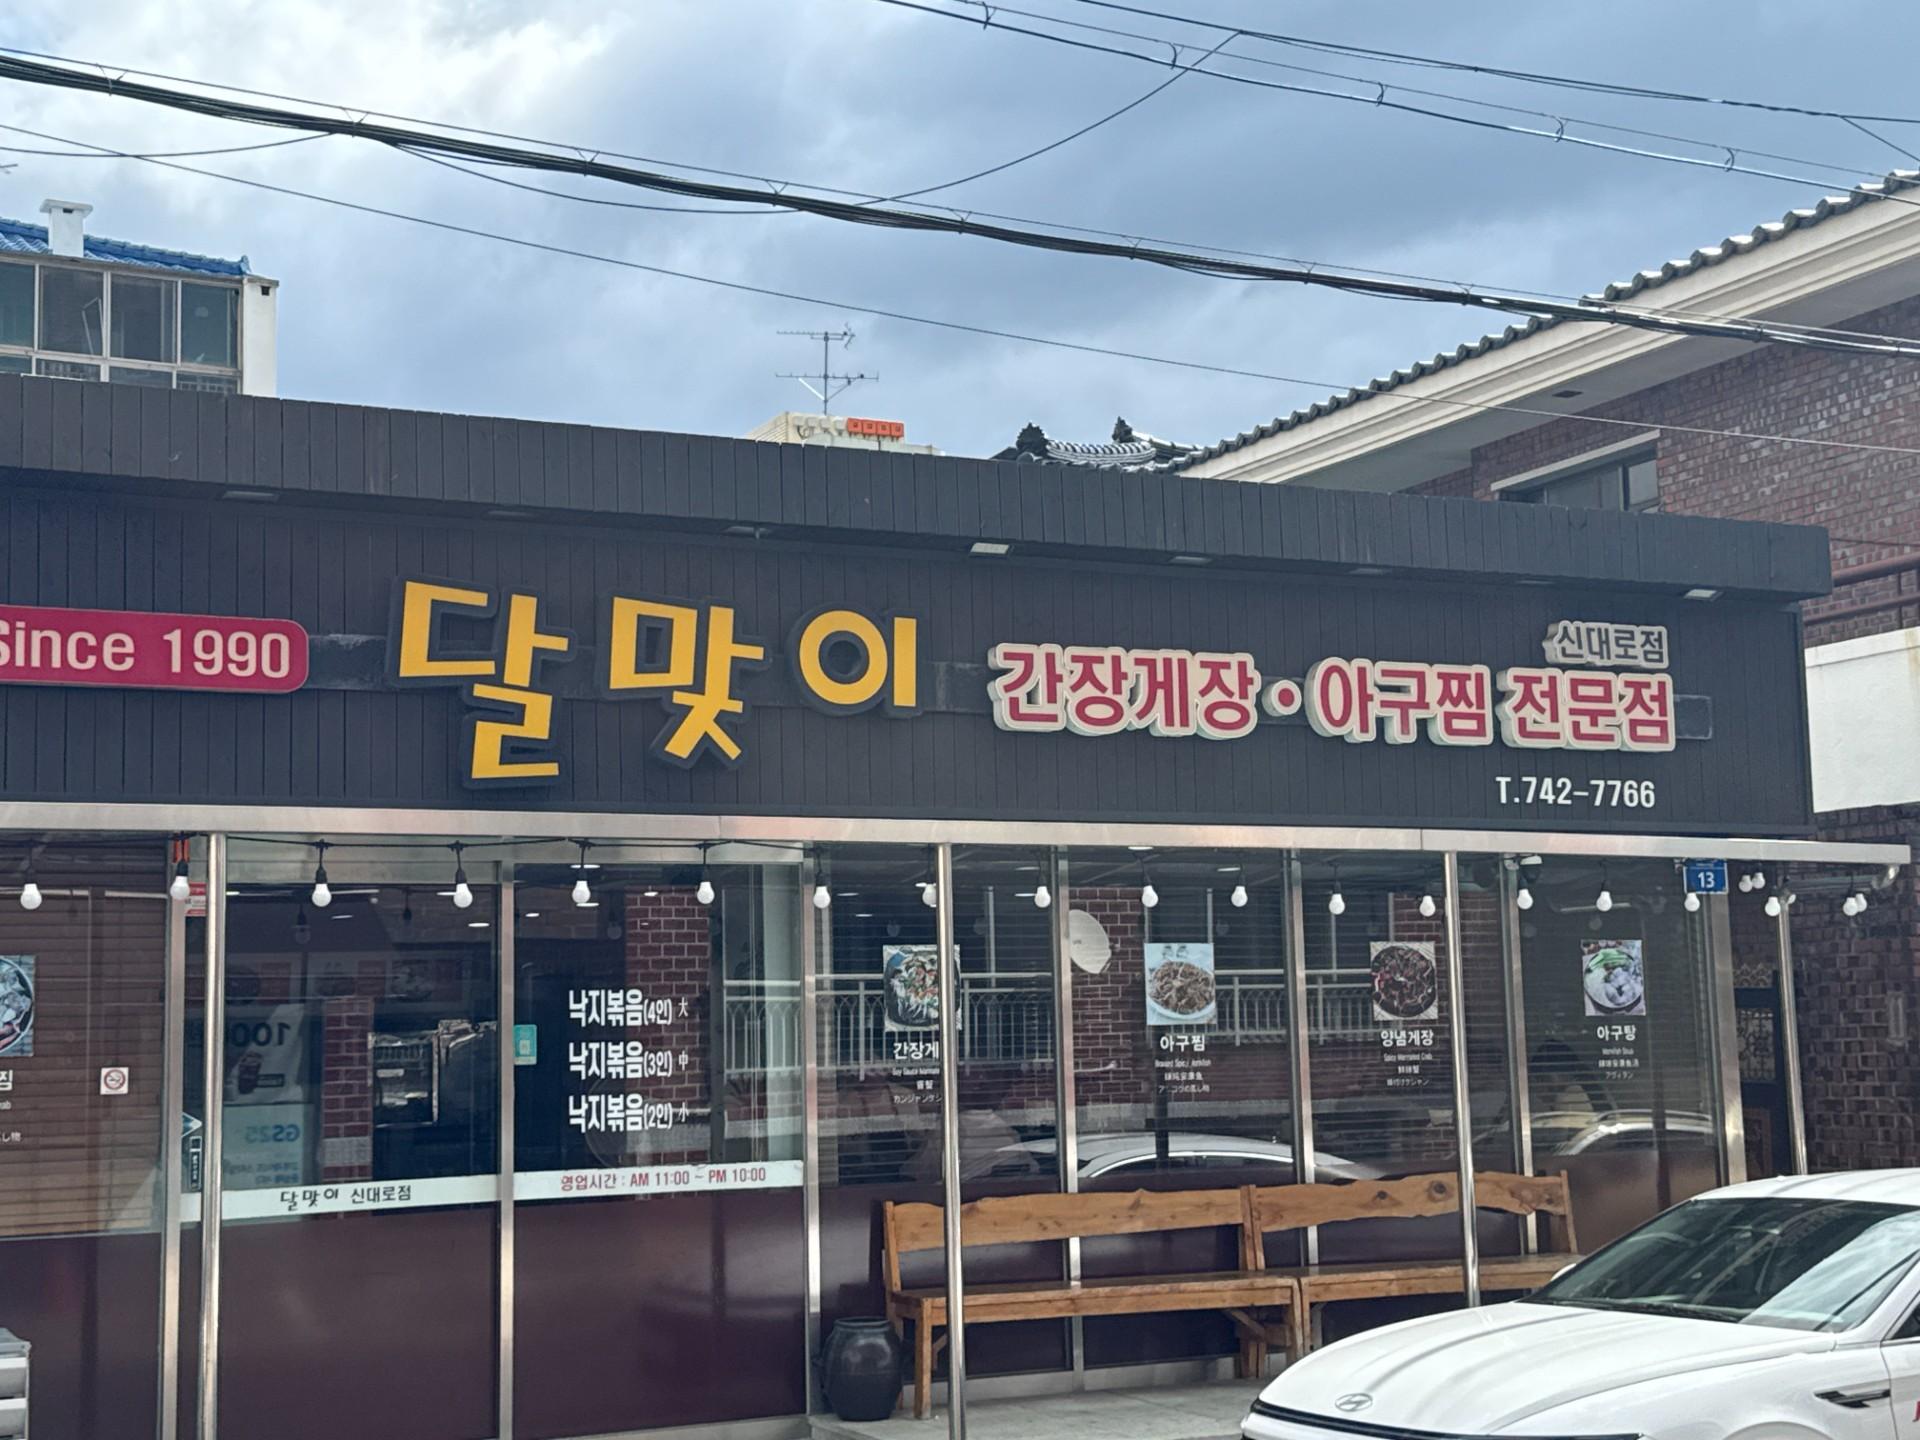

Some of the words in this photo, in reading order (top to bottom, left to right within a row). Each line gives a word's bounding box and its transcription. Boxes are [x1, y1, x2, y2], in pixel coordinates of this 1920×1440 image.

[163, 628, 290, 679] 1990
[1557, 625, 1664, 663] 신대로점
[1511, 674, 1670, 745] 전문점
[1495, 776, 1656, 808] T.742-7766
[1697, 871, 1715, 888] 13
[568, 989, 673, 1027] 낙지볶음(4인)
[678, 996, 689, 1018] 大
[1160, 1033, 1206, 1052] 아구찜
[1380, 1029, 1434, 1047] 양념게장
[1596, 1024, 1637, 1041] 아구탕
[568, 1041, 673, 1080] 낙지볶음(3인)
[678, 1050, 689, 1071] 中
[893, 1040, 939, 1060] 간장게
[568, 1093, 673, 1133] 낙지볶음(2인)
[678, 1101, 689, 1123] 小
[561, 1173, 617, 1192] 영업시간
[630, 1173, 649, 1187] AM
[655, 1171, 690, 1186] 11:00
[708, 1169, 727, 1183] PM
[732, 1167, 766, 1182] 10:00
[350, 1185, 412, 1204] 신대로점
